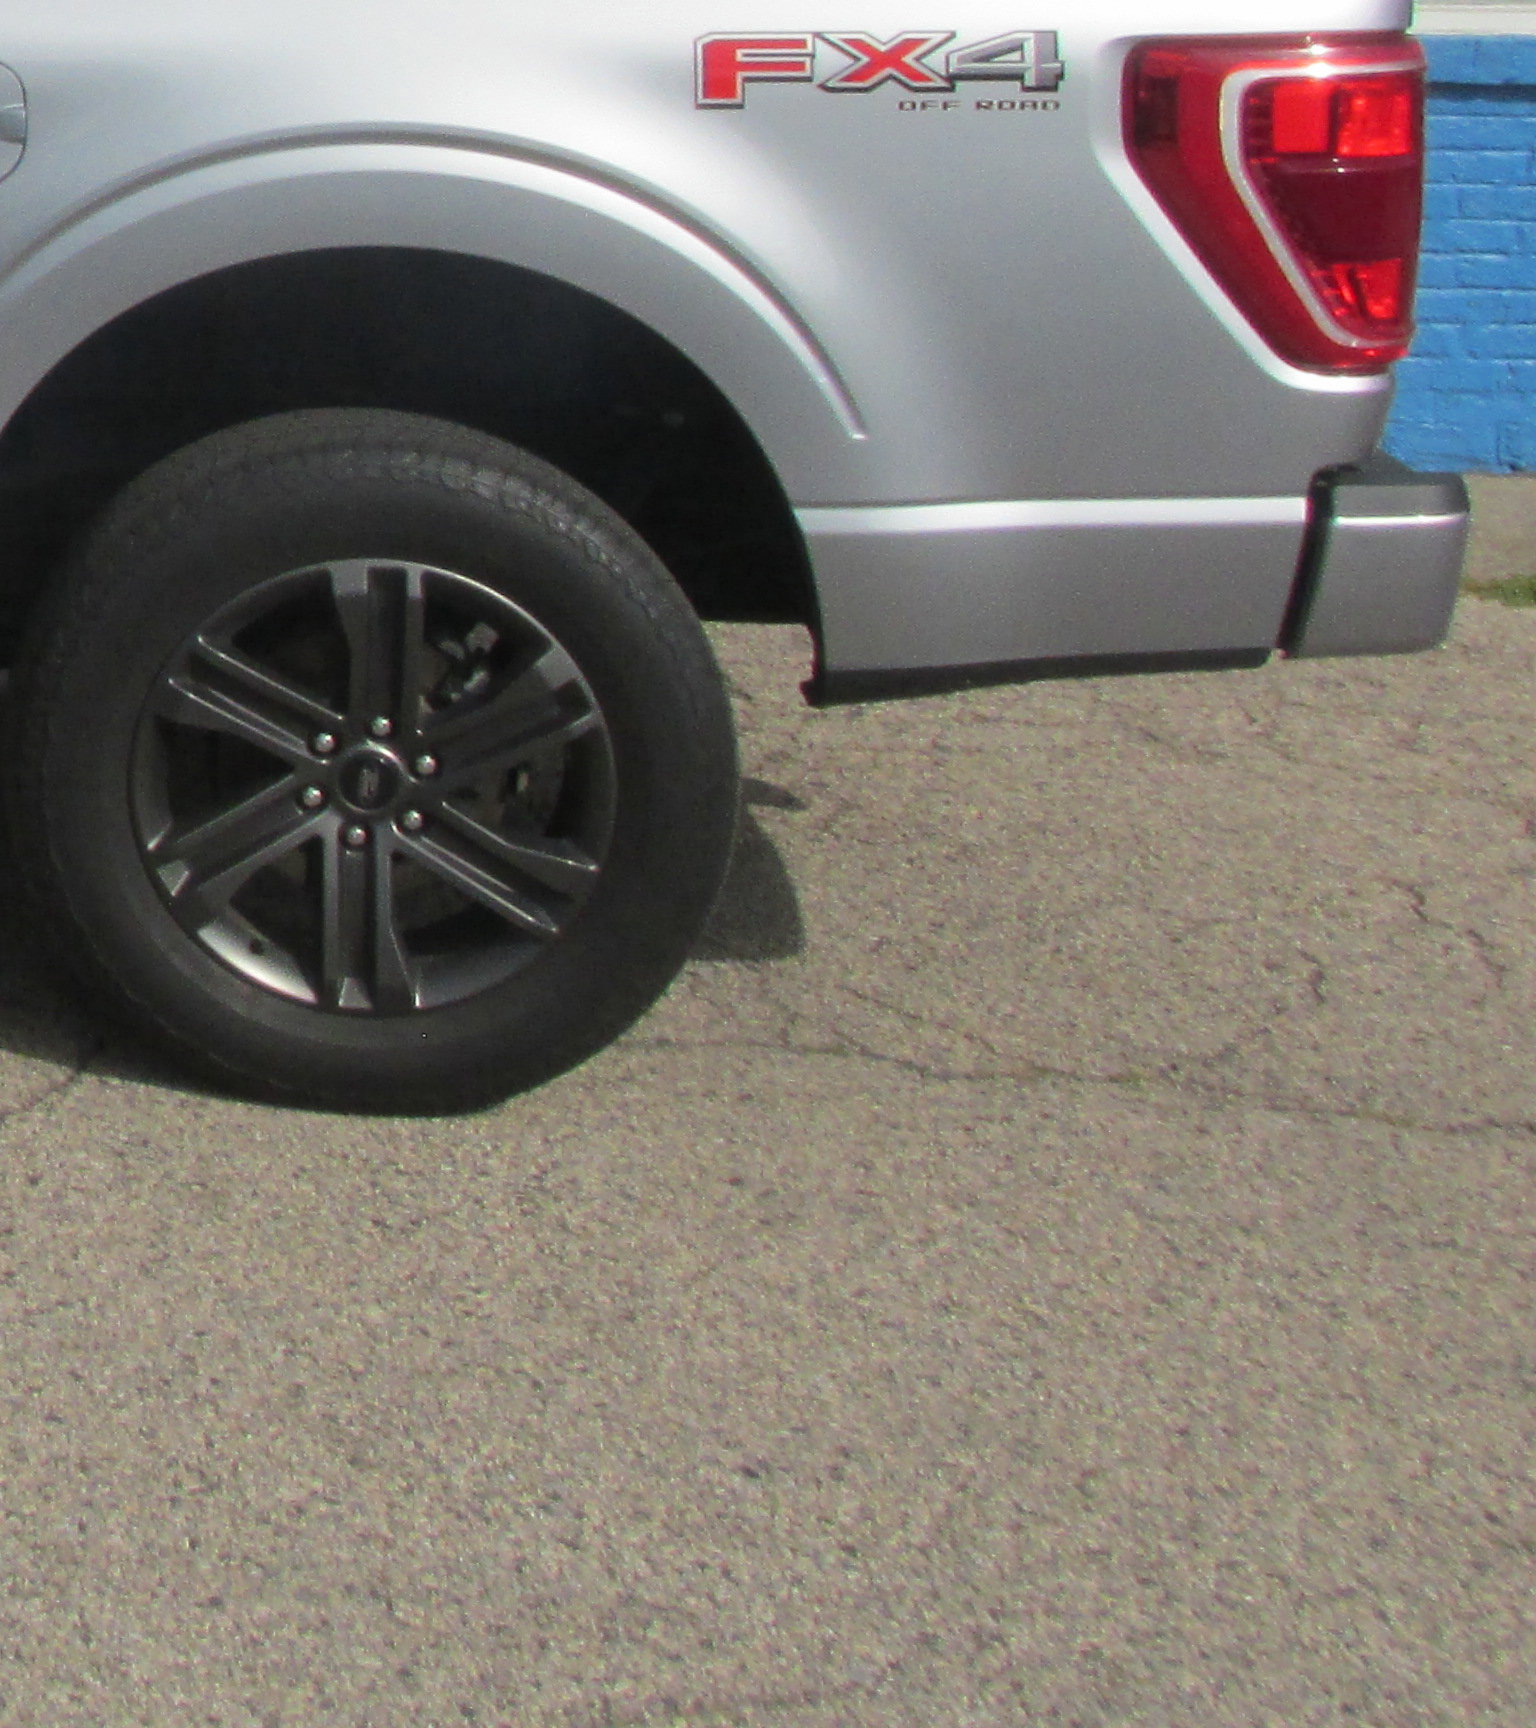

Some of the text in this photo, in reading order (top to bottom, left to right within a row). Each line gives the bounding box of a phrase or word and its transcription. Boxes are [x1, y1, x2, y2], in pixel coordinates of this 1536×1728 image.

[695, 31, 1064, 110] FX4
[897, 98, 1061, 112] OFF ROAD
